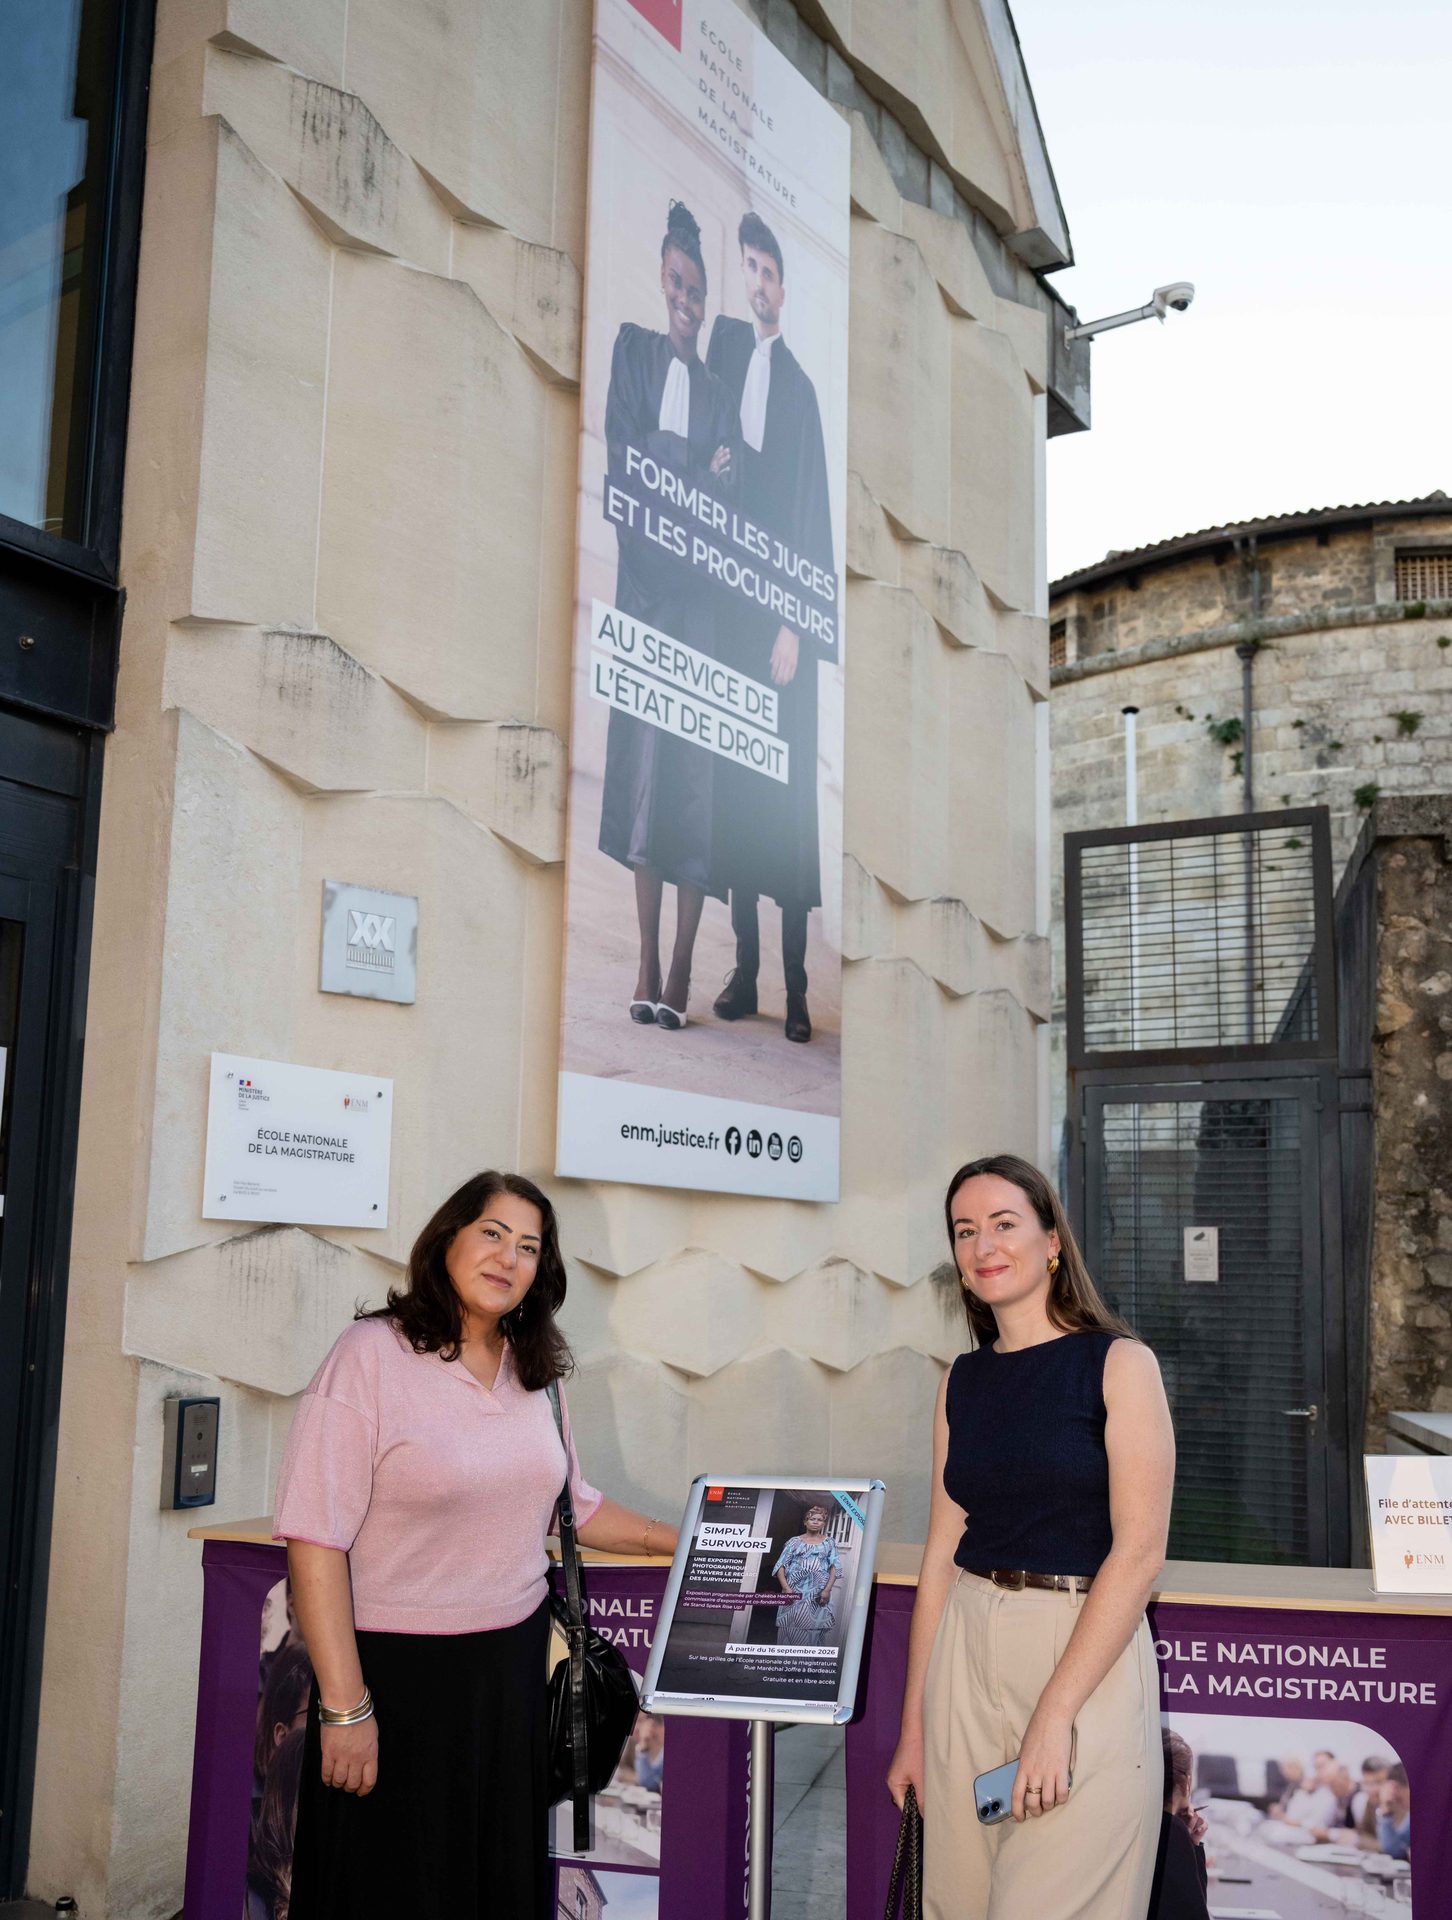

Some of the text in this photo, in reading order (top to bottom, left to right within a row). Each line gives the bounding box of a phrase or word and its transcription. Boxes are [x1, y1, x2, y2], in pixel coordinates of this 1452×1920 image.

[701, 20, 743, 73] ÉCOLE
[699, 78, 737, 122] DE LA
[700, 50, 775, 132] NATIONALE
[699, 106, 797, 209] MAGISTRATURE
[626, 445, 835, 601] FORMER LES JUGES
[608, 485, 834, 645] ET LES PROCUREURS
[598, 613, 774, 724] AU SERVICE DE
[595, 663, 785, 776] L'ÉTAT DE DROIT
[257, 1127, 348, 1149] ÉCOLE NATIONALE
[620, 1123, 720, 1151] enm.justice.fr
[248, 1143, 355, 1163] DE LA MAGISTRATURE
[1378, 1498, 1399, 1509] File
[704, 1526, 746, 1536] SIMPLY
[1384, 1515, 1415, 1525] AVEC
[701, 1538, 767, 1549] SURVIVORS
[692, 1563, 747, 1571] PHOTOGRAPHIQU
[1416, 1552, 1445, 1565] ENM
[702, 1576, 743, 1584] SURVIVANTES
[581, 1598, 654, 1618] NALE
[591, 1626, 654, 1649] RATU
[777, 1647, 817, 1655] septembre
[1155, 1640, 1387, 1669] OLE NATIONALE
[1163, 1672, 1437, 1706] LA MAGISTRATURE
